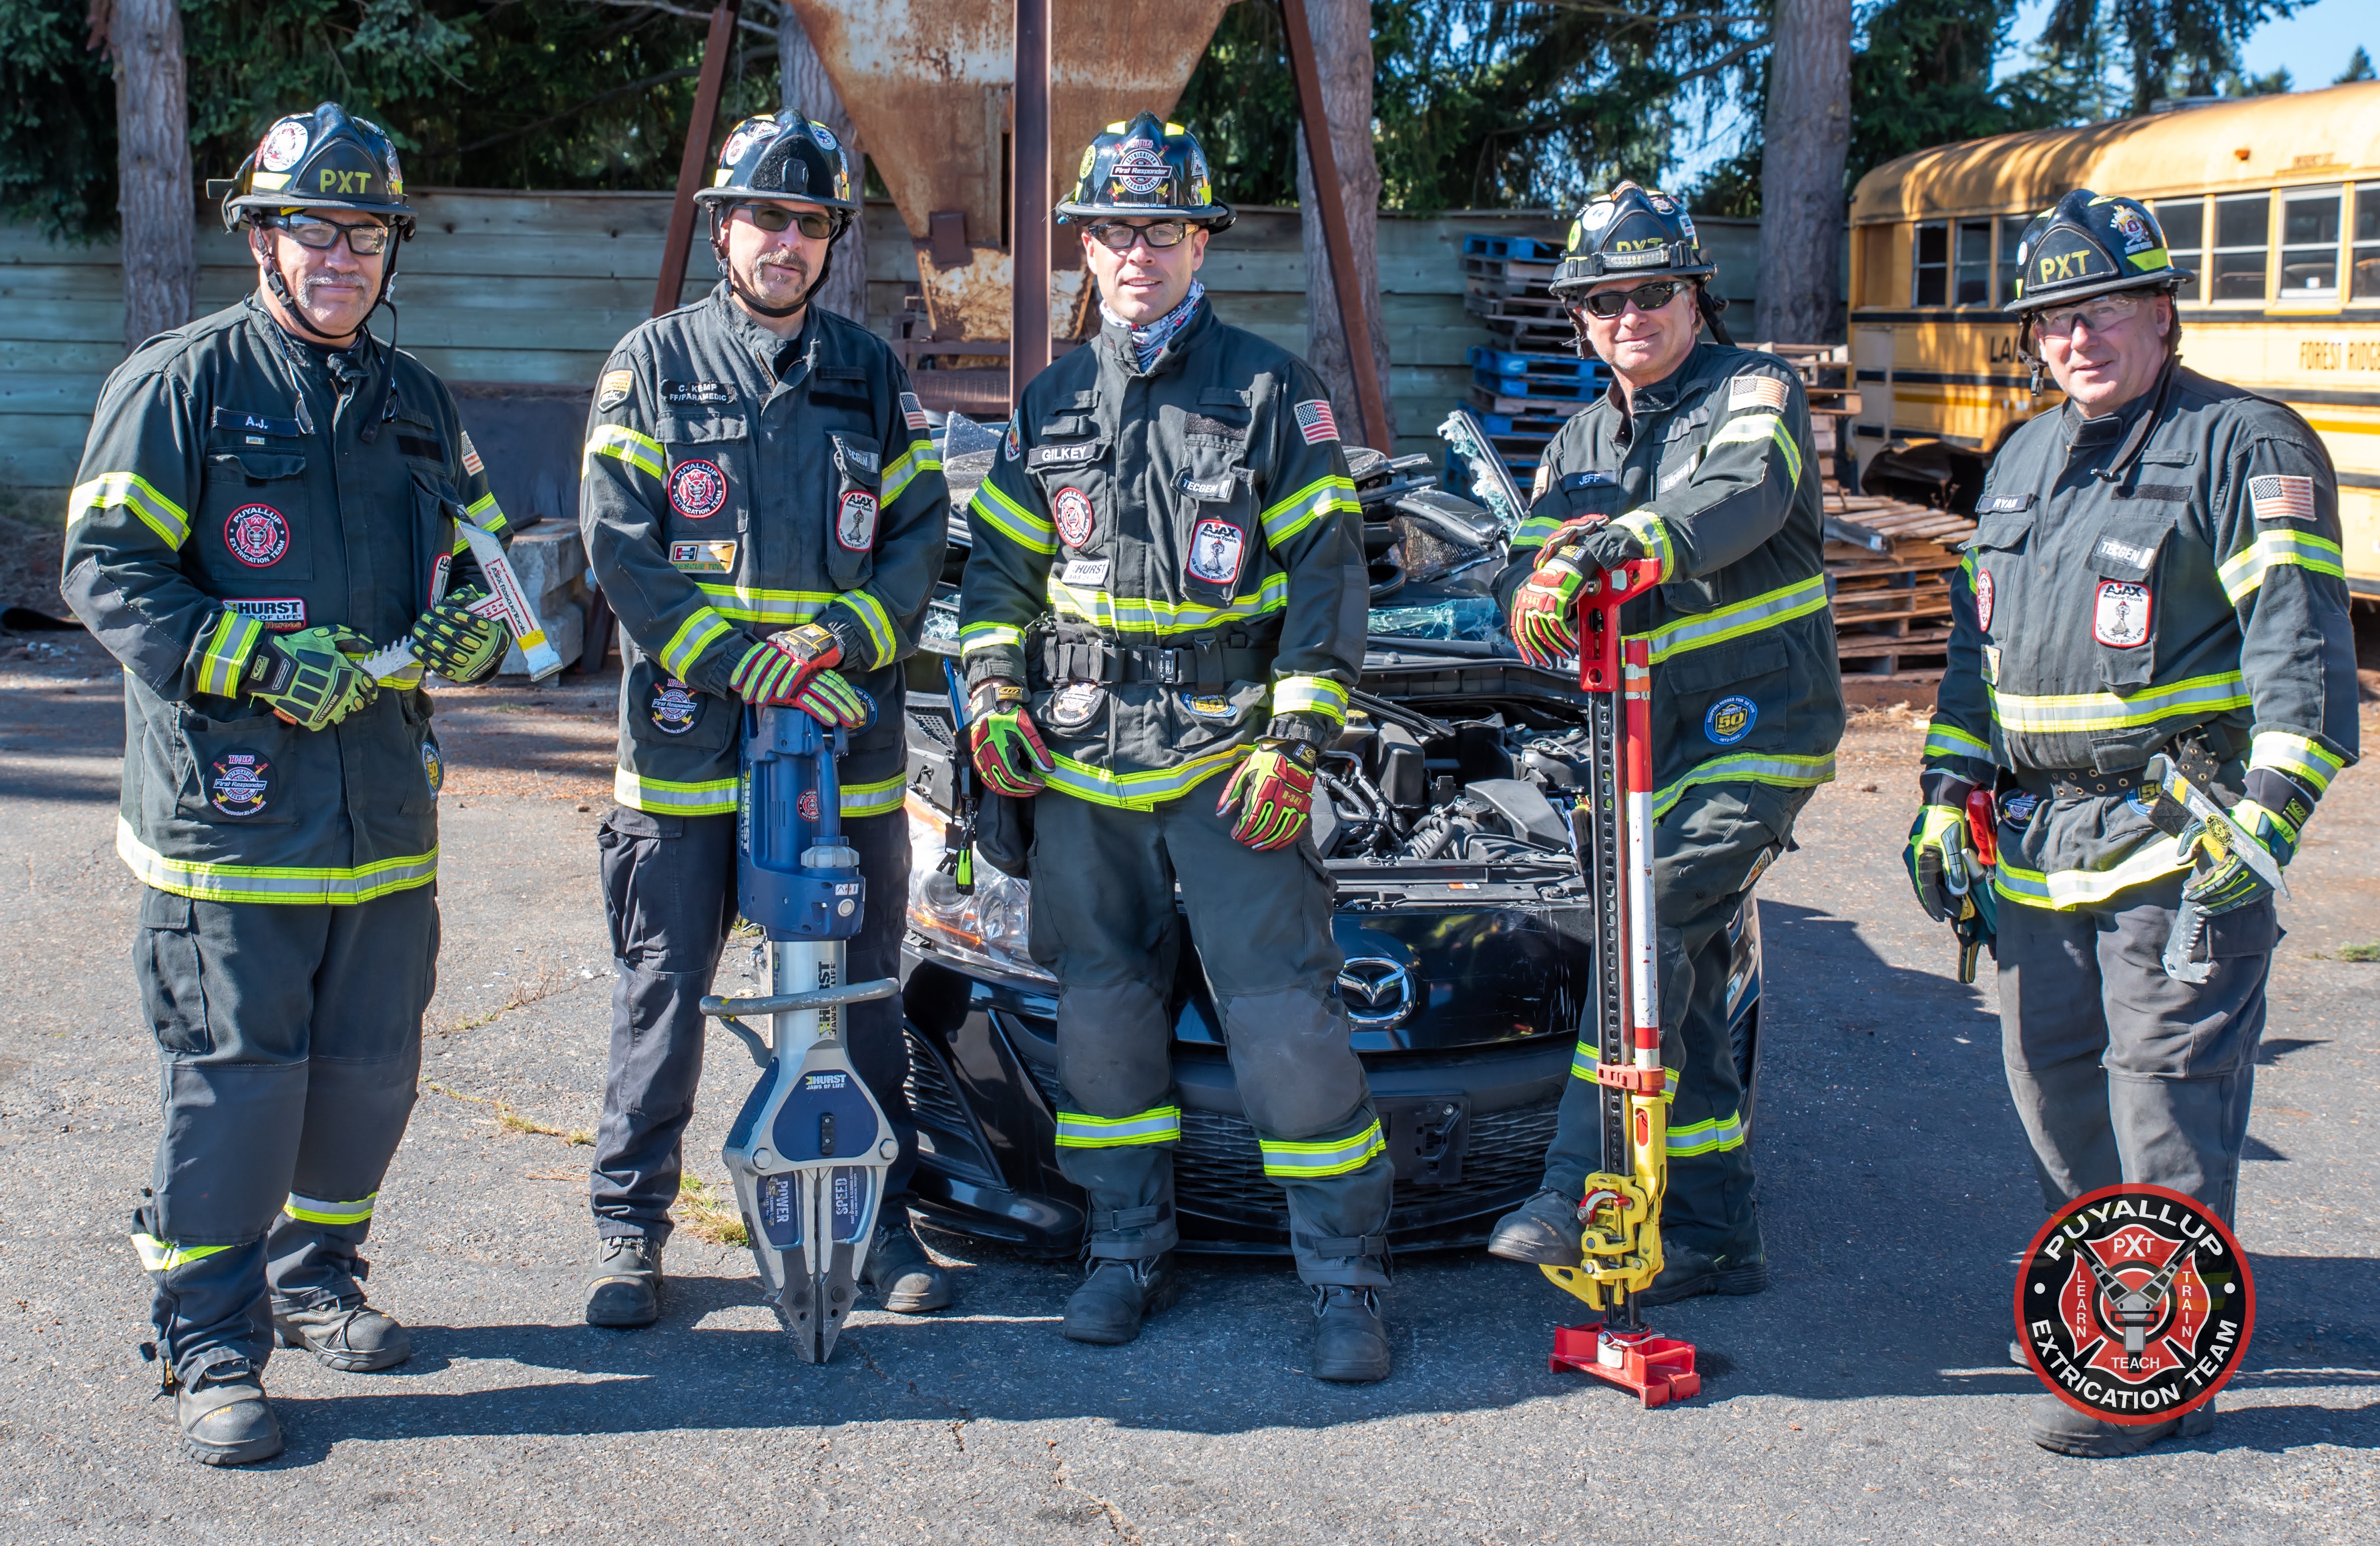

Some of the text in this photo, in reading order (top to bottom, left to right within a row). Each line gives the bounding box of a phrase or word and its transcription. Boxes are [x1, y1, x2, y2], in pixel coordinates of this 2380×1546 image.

[1131, 139, 1153, 149] Hi-Lift
[1126, 152, 1156, 164] EXTRICATION
[320, 169, 371, 194] PXT
[1125, 178, 1156, 191] RESCUE TOOL
[2040, 249, 2090, 284] PXT
[2299, 341, 2341, 370] FOREST
[692, 383, 717, 392] KEMP
[669, 392, 727, 401] FF/PARAMEDIC
[245, 415, 269, 430] A.J.
[1041, 446, 1087, 462] GILKEY
[675, 463, 718, 480] PUYALLUP
[1182, 478, 1219, 493] TECGEN
[1578, 473, 1601, 486] JEFF
[673, 490, 723, 515] EXTRICATION TEAM
[846, 502, 861, 510] Rescue
[1992, 498, 2018, 509] RYAN
[233, 507, 282, 524] PUYALLUP
[229, 537, 286, 564] EXTRICATION TEAM
[2101, 541, 2142, 563] TECGEN
[1075, 564, 1107, 574] HURST
[1194, 565, 1210, 579] HAMMER
[238, 602, 301, 614] HURST
[499, 584, 516, 613] Rescue
[513, 609, 527, 636] Tools
[265, 621, 302, 629] Heroes
[664, 692, 686, 701] EXTRICATION
[1718, 712, 1744, 728] 50
[229, 755, 255, 765] Hi-Lift
[227, 770, 254, 779] EXTRICATION
[812, 1074, 847, 1084] HURST
[776, 1181, 789, 1223] POWER
[835, 1177, 848, 1215] SPEED
[205, 1406, 233, 1423] GLOBE
